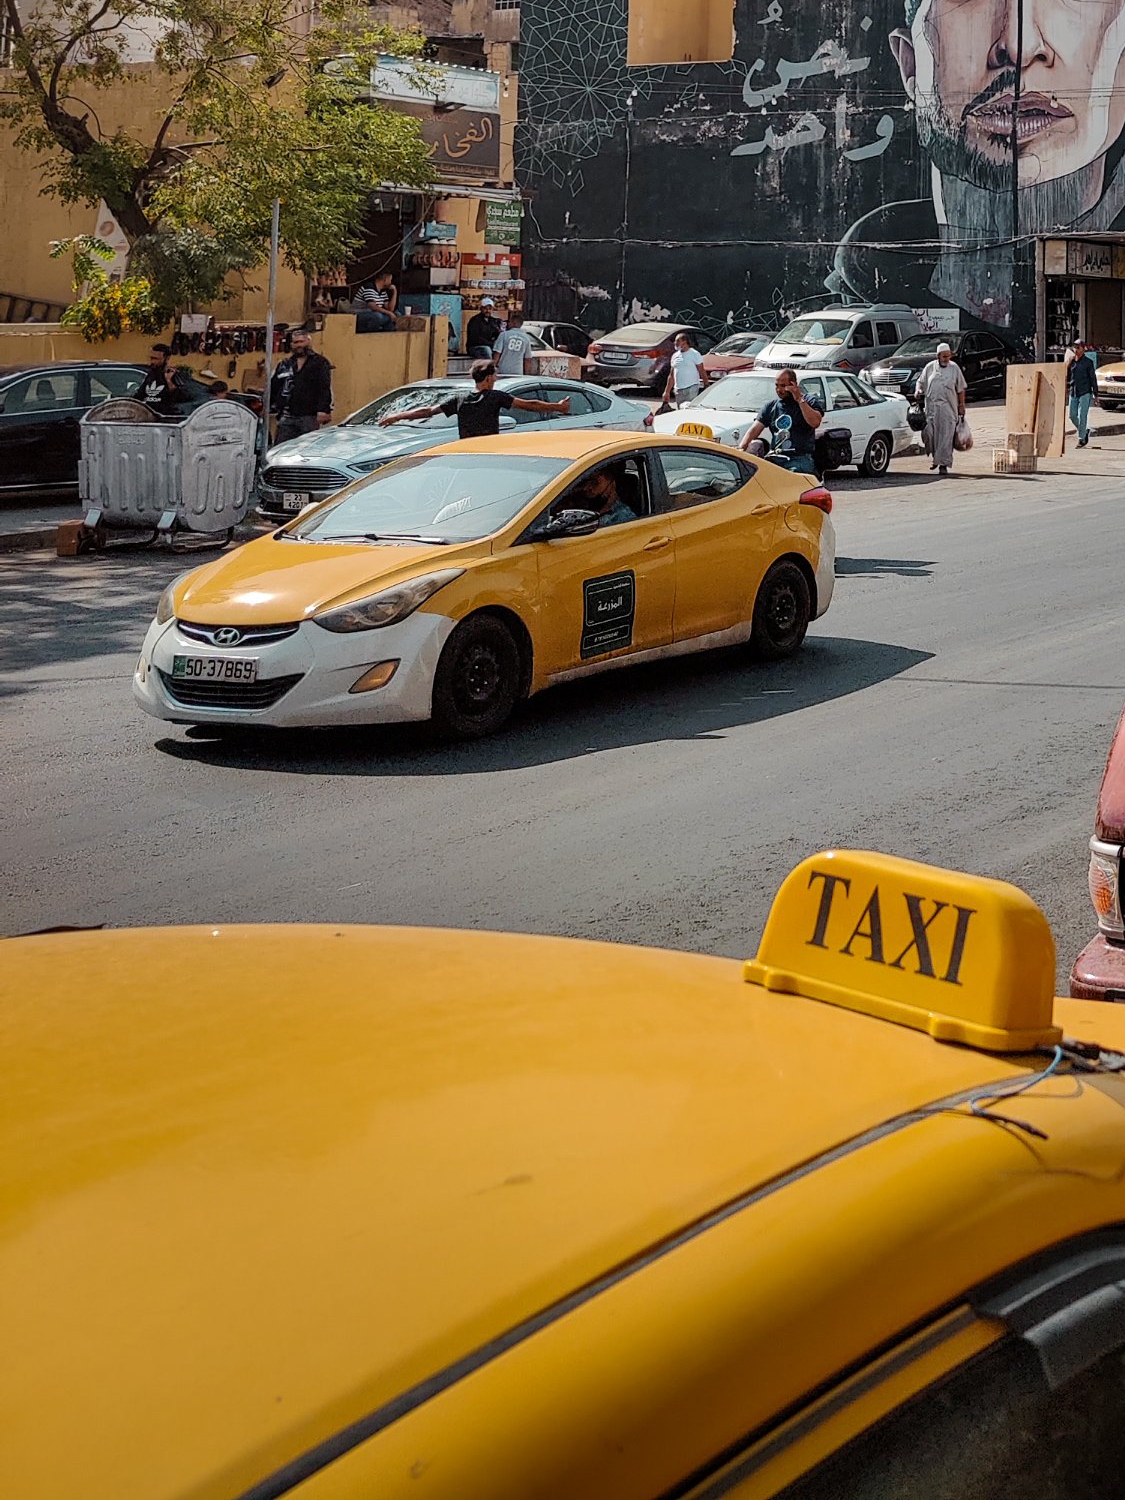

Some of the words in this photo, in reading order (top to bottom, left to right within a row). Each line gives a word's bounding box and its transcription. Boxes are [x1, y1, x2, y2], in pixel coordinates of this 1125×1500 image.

[730, 93, 894, 161] واحد
[508, 338, 522, 352] 68
[680, 423, 704, 436] TAXI
[805, 870, 977, 987] TAXI
